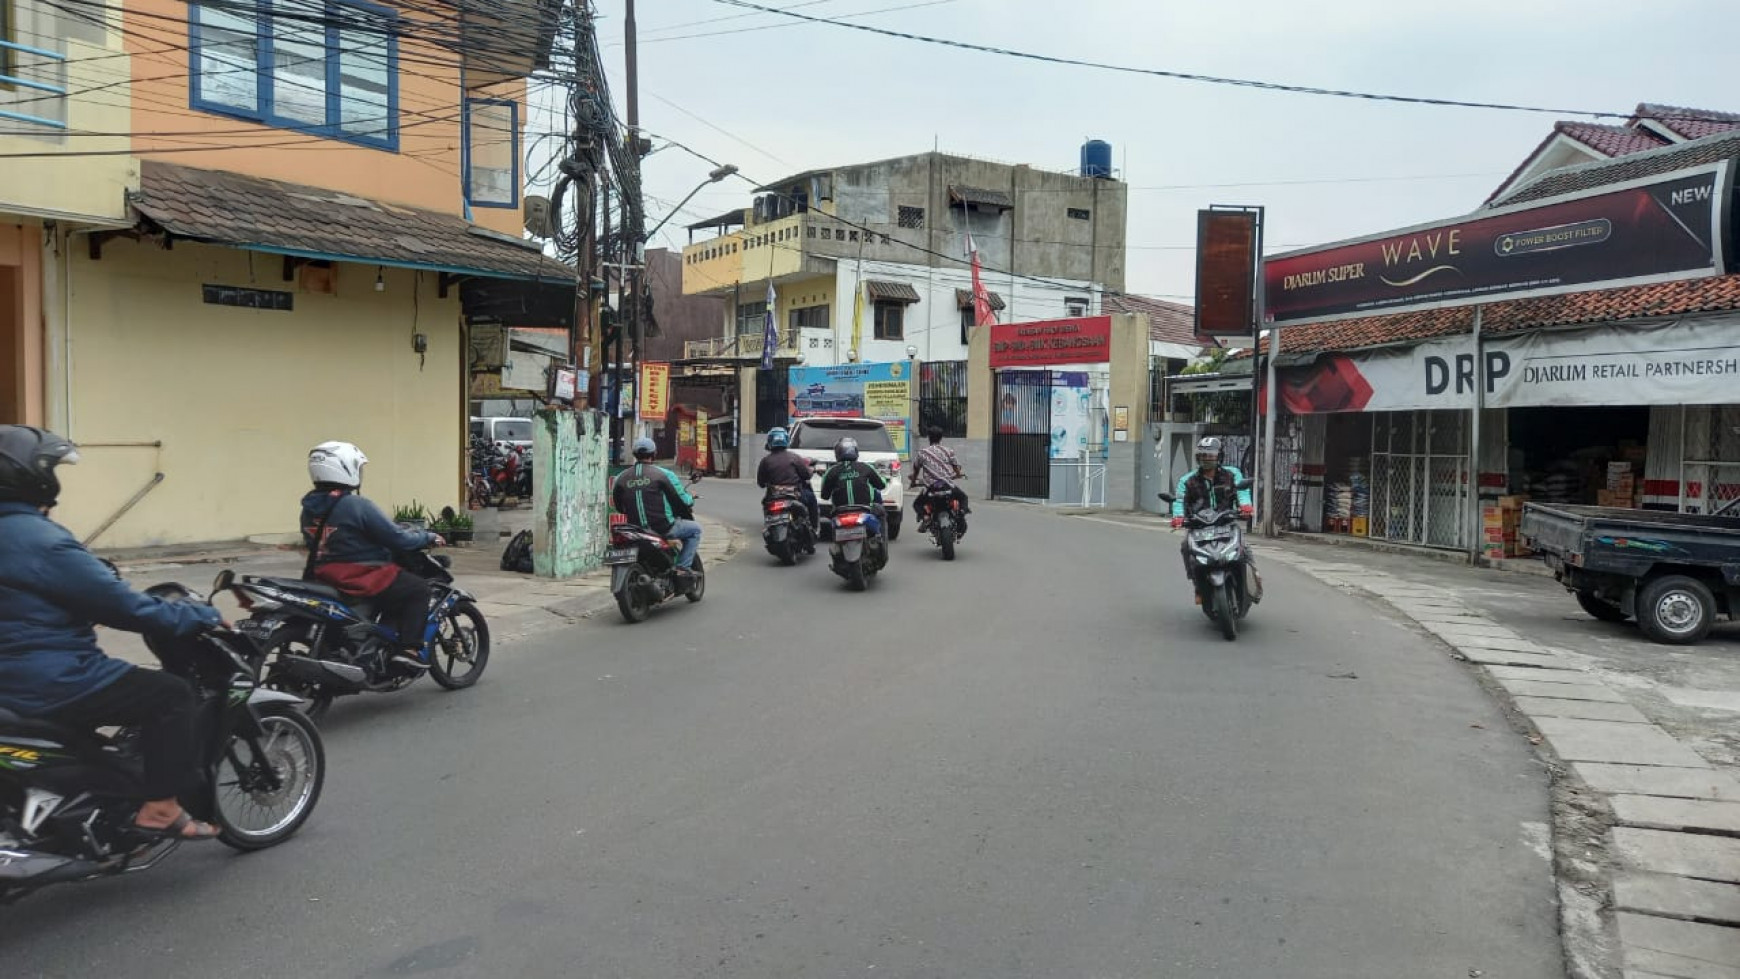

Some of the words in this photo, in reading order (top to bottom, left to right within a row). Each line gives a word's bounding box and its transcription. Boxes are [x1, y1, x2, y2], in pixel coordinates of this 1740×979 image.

[1671, 185, 1712, 206] NEW
[1381, 230, 1461, 267] WAVE
[1515, 235, 1544, 247] POWER
[1546, 231, 1573, 244] BOOST
[1575, 226, 1603, 240] FILTER
[1284, 270, 1326, 291] DJARUM
[1328, 262, 1365, 283] SUPER
[1424, 351, 1511, 395] DRP
[1523, 364, 1586, 384] DJARUM
[1592, 363, 1639, 379] RETAIL
